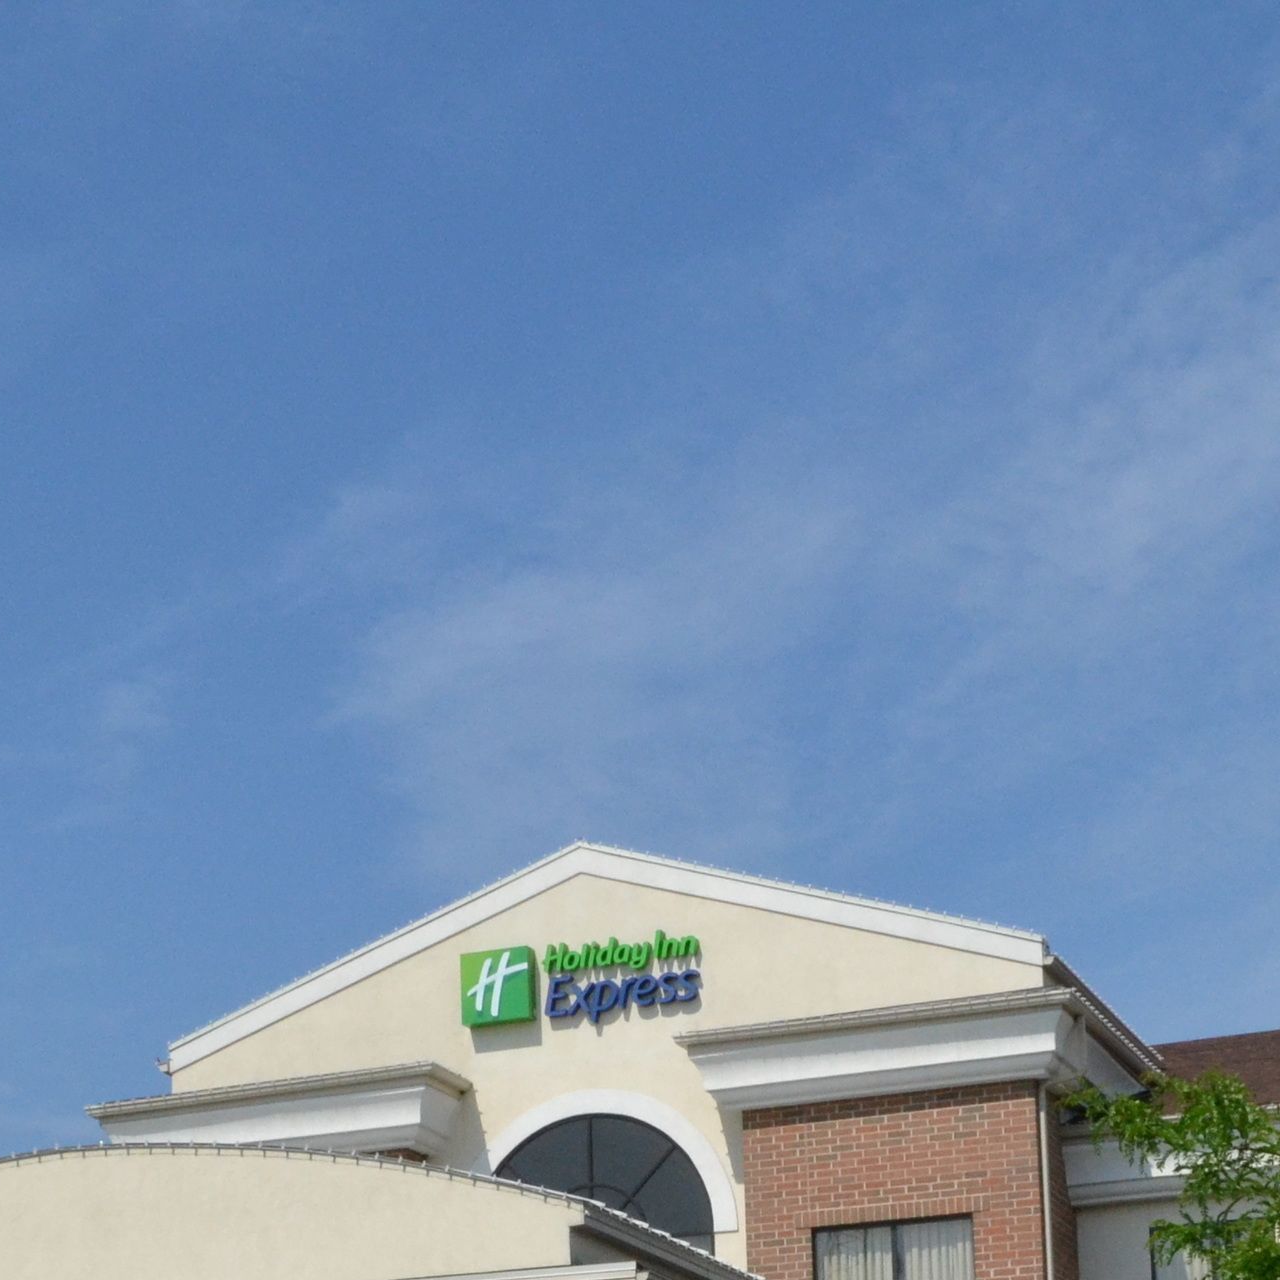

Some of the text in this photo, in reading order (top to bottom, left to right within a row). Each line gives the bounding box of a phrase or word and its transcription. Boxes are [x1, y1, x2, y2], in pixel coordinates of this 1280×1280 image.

[542, 929, 699, 973] Holiday Inn
[467, 951, 528, 1017] H
[544, 969, 700, 1022] Express
